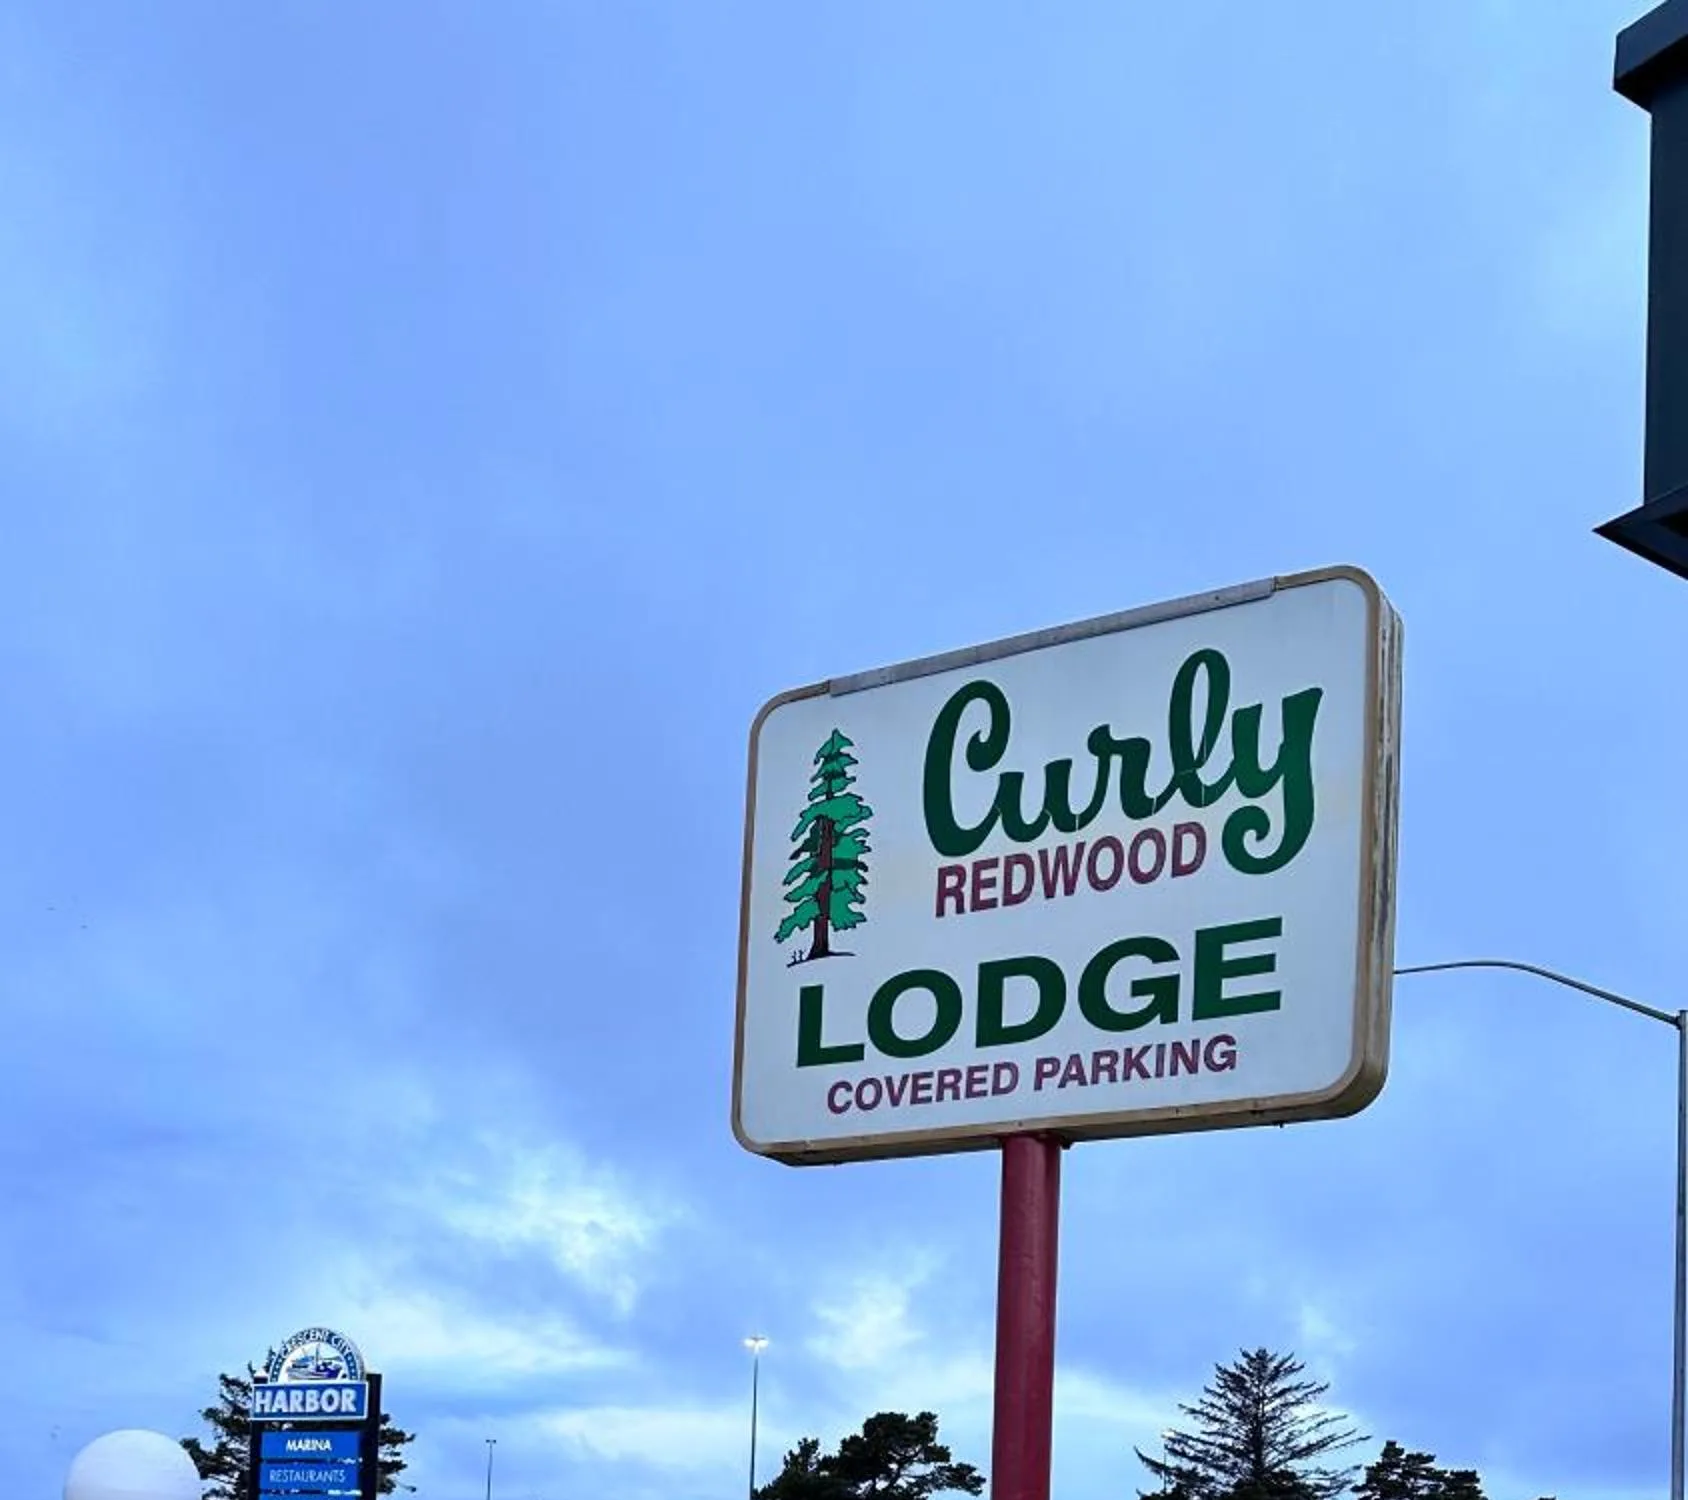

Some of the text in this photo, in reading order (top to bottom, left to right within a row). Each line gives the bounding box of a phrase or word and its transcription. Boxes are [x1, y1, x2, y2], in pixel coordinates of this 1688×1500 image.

[923, 648, 1323, 875] Curly
[935, 821, 1207, 918] REDWOOD
[796, 917, 1283, 1069] LODGE
[827, 1033, 1237, 1115] COVERED PARKING
[331, 1335, 352, 1355] CITY
[254, 1388, 357, 1414] HARBOR
[285, 1439, 333, 1452] MARINA
[269, 1469, 346, 1483] RESTAURANTS
